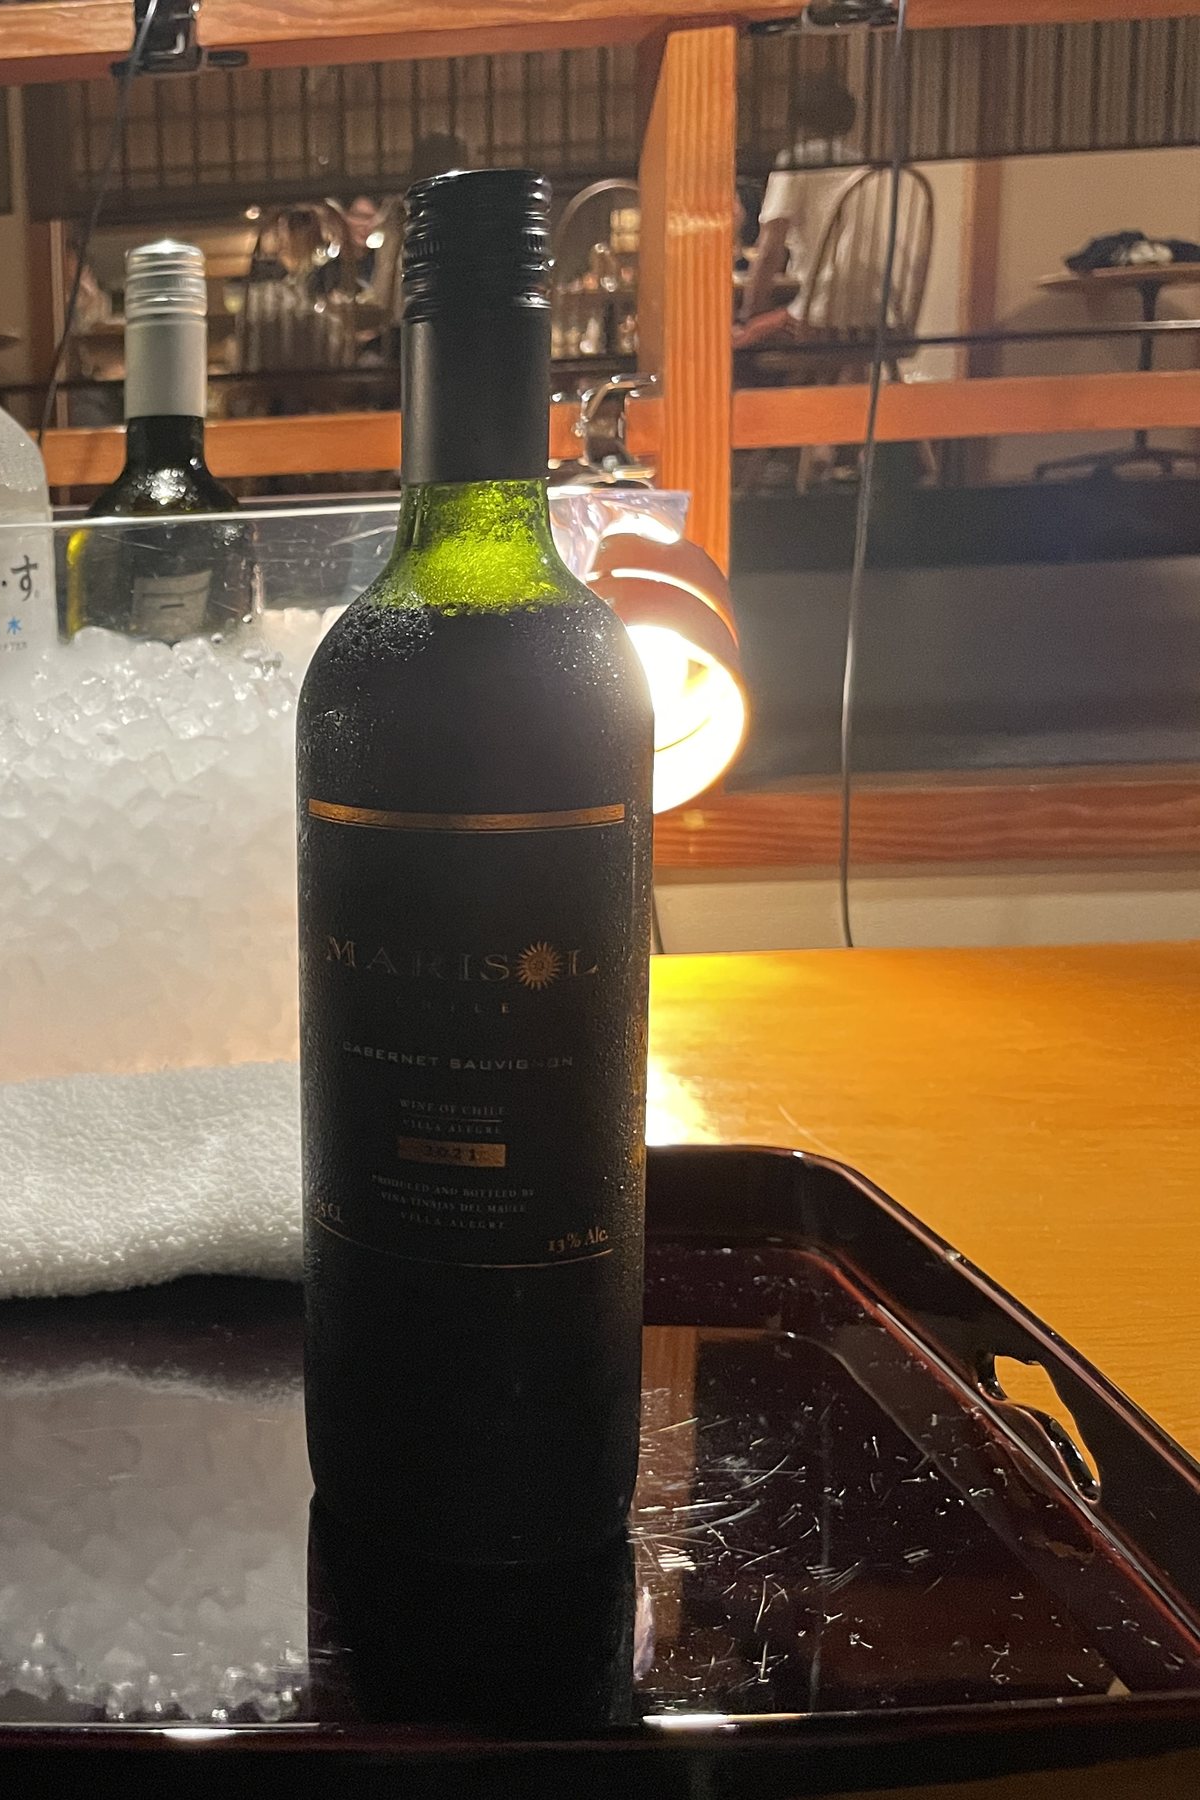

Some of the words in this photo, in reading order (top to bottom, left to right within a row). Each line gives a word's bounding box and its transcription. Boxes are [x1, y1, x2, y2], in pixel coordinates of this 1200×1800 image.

[326, 935, 599, 991] MARISOL
[342, 1040, 439, 1067] CABERNET
[399, 1098, 434, 1112] WINE
[438, 1104, 455, 1115] OF
[461, 1105, 506, 1116] CHILE
[371, 1173, 431, 1194] PRODUCED
[433, 1185, 458, 1196] AND
[462, 1188, 518, 1199] BOTTLED
[459, 1202, 483, 1213] DEL
[547, 1231, 582, 1254] 13%
